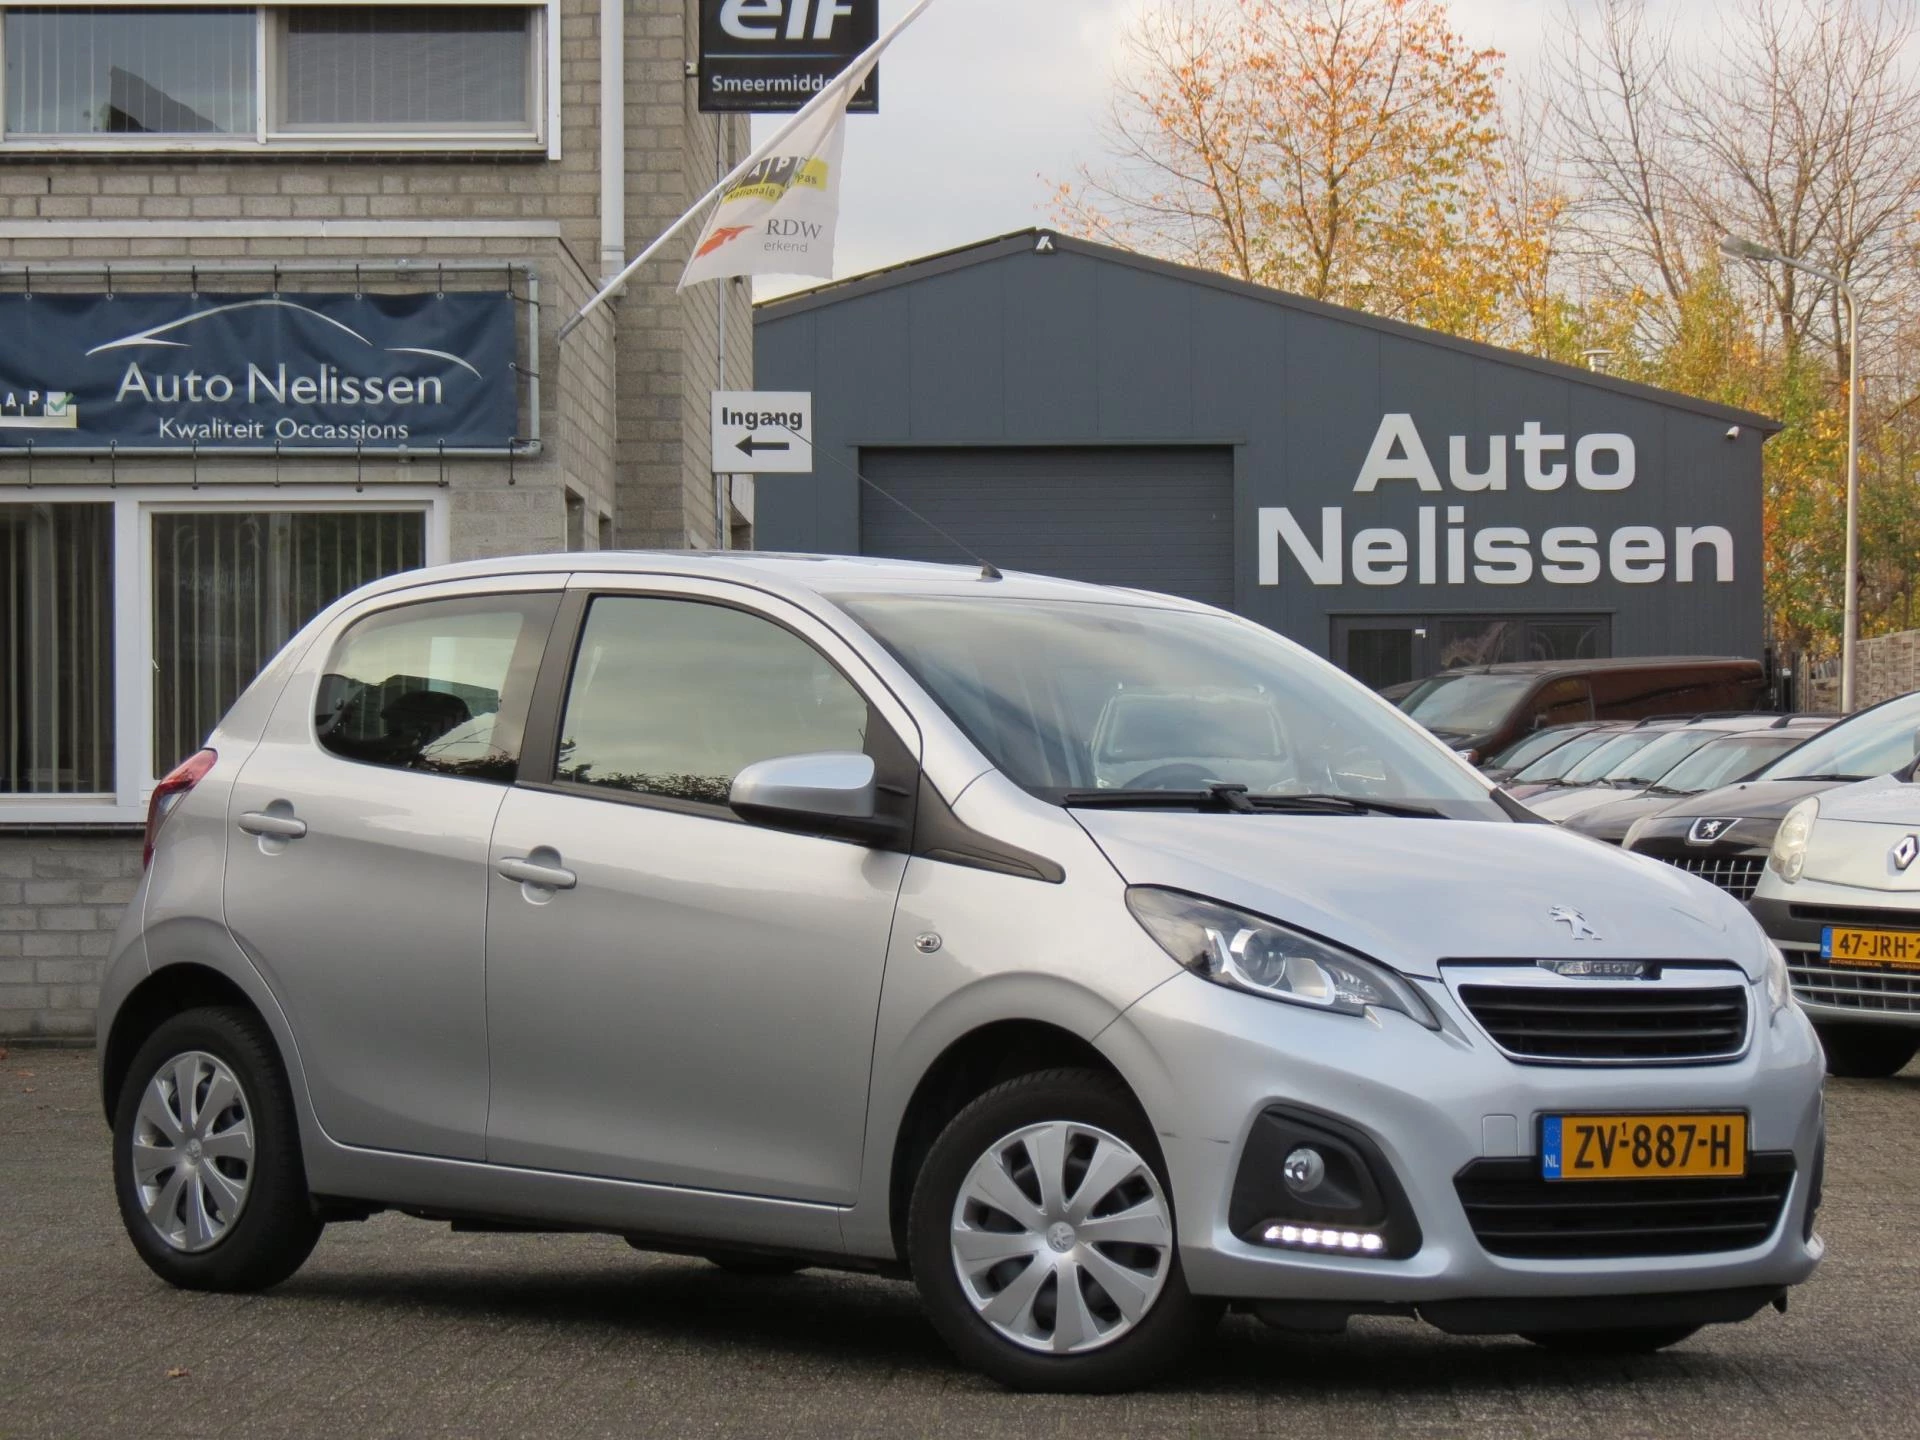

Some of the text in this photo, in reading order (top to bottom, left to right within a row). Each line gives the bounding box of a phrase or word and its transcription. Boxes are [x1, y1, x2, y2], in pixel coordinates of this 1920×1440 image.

[719, 0, 852, 40] elf
[712, 74, 866, 92] Smeermidde
[766, 219, 822, 239] RDW
[764, 240, 808, 252] erkend
[115, 355, 443, 405] Auto Nelissen
[159, 417, 409, 440] Kwaliteit Occassions
[722, 407, 803, 431] Ingang
[1353, 413, 1636, 492] Auto
[1258, 505, 1734, 586] Nelissen
[1545, 1155, 1559, 1168] NL
